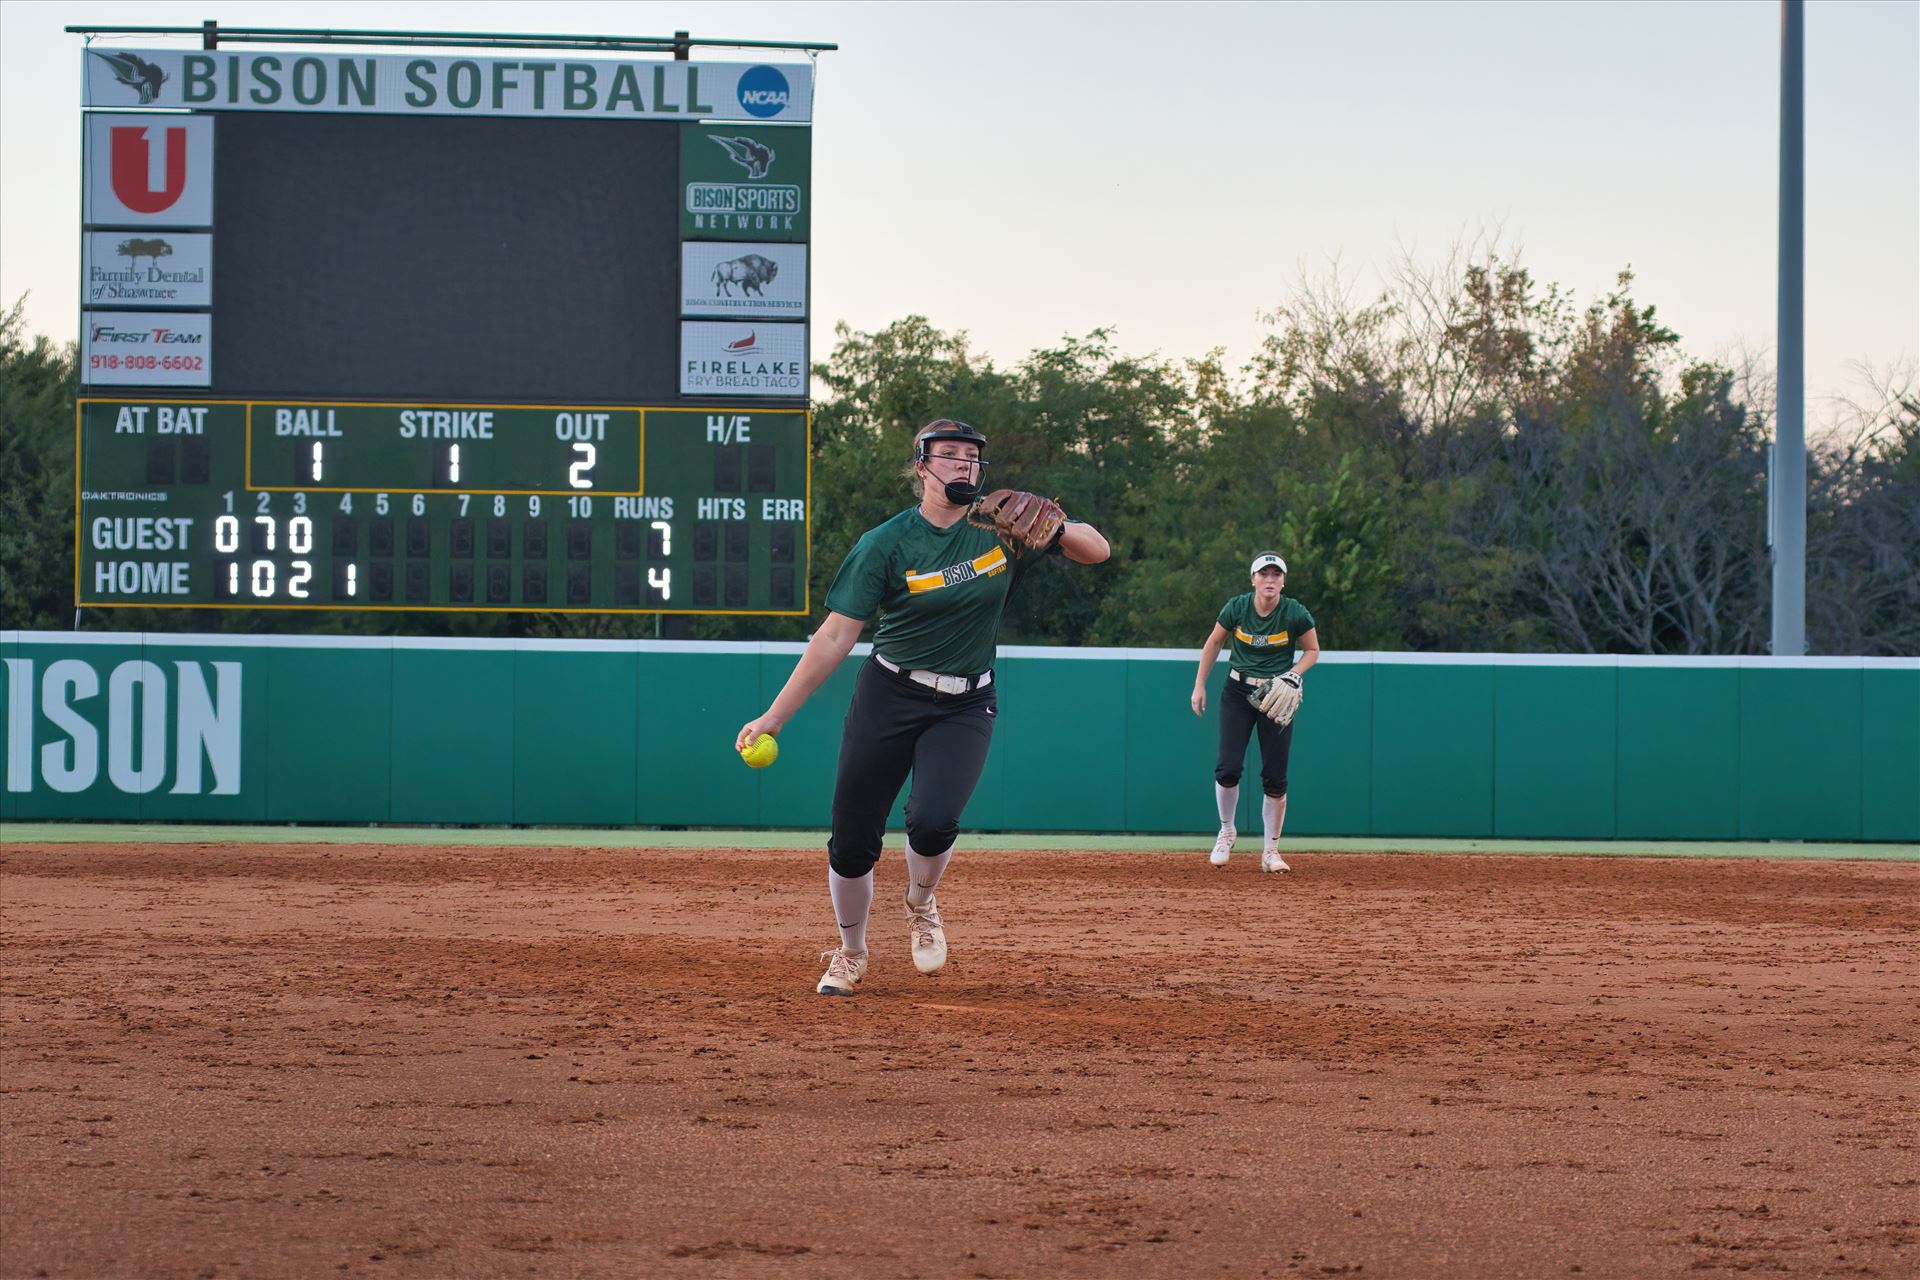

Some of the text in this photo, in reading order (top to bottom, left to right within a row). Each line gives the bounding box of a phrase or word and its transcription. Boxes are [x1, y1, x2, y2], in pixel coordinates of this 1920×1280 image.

[182, 55, 712, 113] BISON SOFTBALL
[743, 90, 787, 105] NCAA
[694, 187, 795, 210] BISON SPORTS
[695, 214, 792, 229] NETWORK
[91, 266, 204, 285] Family Dental
[92, 283, 177, 299] of Shawnee
[152, 328, 203, 344] TEAM
[687, 361, 800, 375] FIRELAKE
[687, 376, 800, 388] FRY BREAD TACO
[115, 407, 208, 434] AT BAT
[275, 409, 342, 437] BALL
[400, 410, 493, 440] STRIKE
[555, 413, 610, 441] OUT
[706, 415, 751, 445] H/E
[312, 441, 322, 482] 1
[449, 443, 460, 483] 1
[569, 442, 596, 489] 2
[81, 491, 168, 501] DAKTRONICS
[223, 491, 804, 521] 1 2 3 4 5 6 7 8 9 10 RUNS HITS ERR
[92, 517, 193, 551] GUEST
[215, 516, 312, 554] 0 7 0
[651, 522, 672, 556] 7
[95, 561, 190, 594] HOME
[251, 560, 275, 598] 0
[288, 561, 312, 598] 2
[347, 563, 357, 597] 1
[648, 568, 672, 600] 4
[941, 560, 978, 588] BISON
[3, 658, 242, 796] ISON
